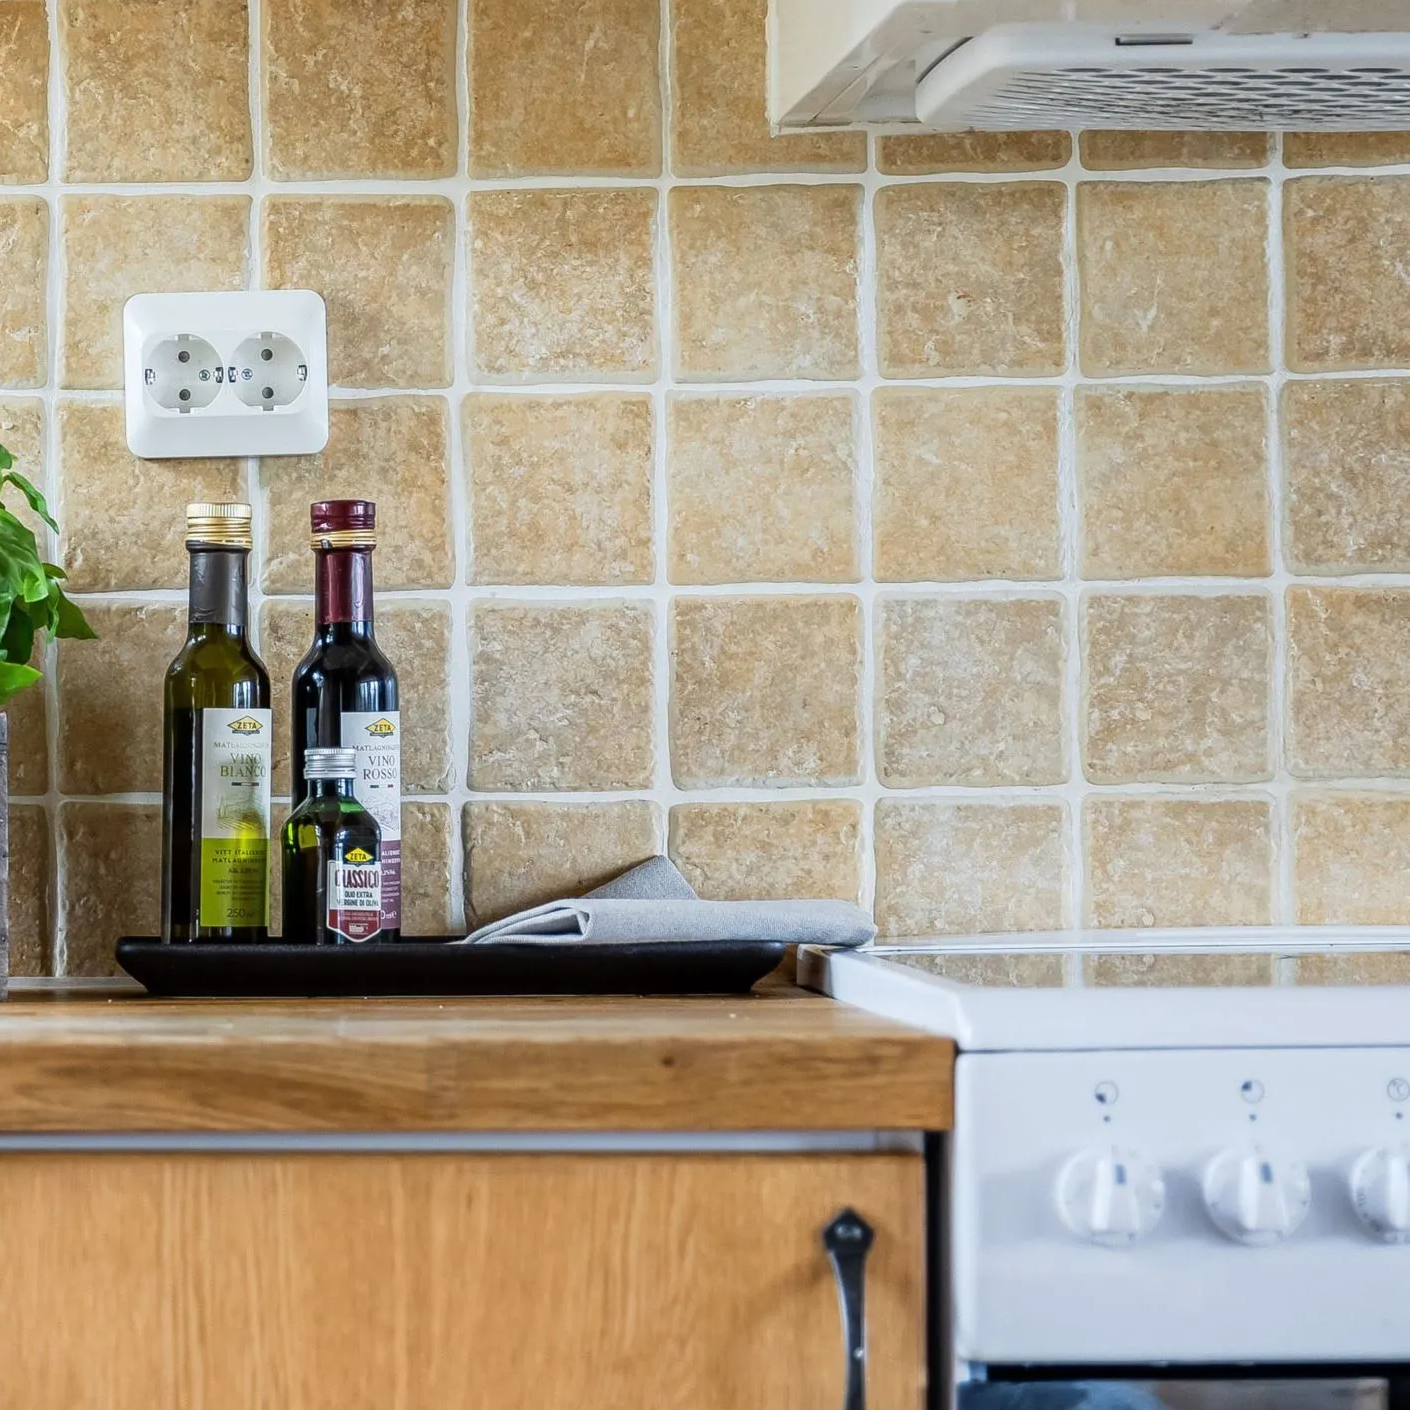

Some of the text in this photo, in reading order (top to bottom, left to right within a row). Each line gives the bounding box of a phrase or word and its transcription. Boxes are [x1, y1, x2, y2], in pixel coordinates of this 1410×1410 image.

[237, 721, 257, 729] ZETA
[374, 724, 392, 732] ZETA
[230, 752, 262, 764] VINO
[368, 755, 396, 766] VINO
[220, 765, 267, 778] BIANCO
[363, 768, 398, 780] ROSSO
[335, 869, 380, 889] CLASSICO
[226, 908, 246, 918] 250
